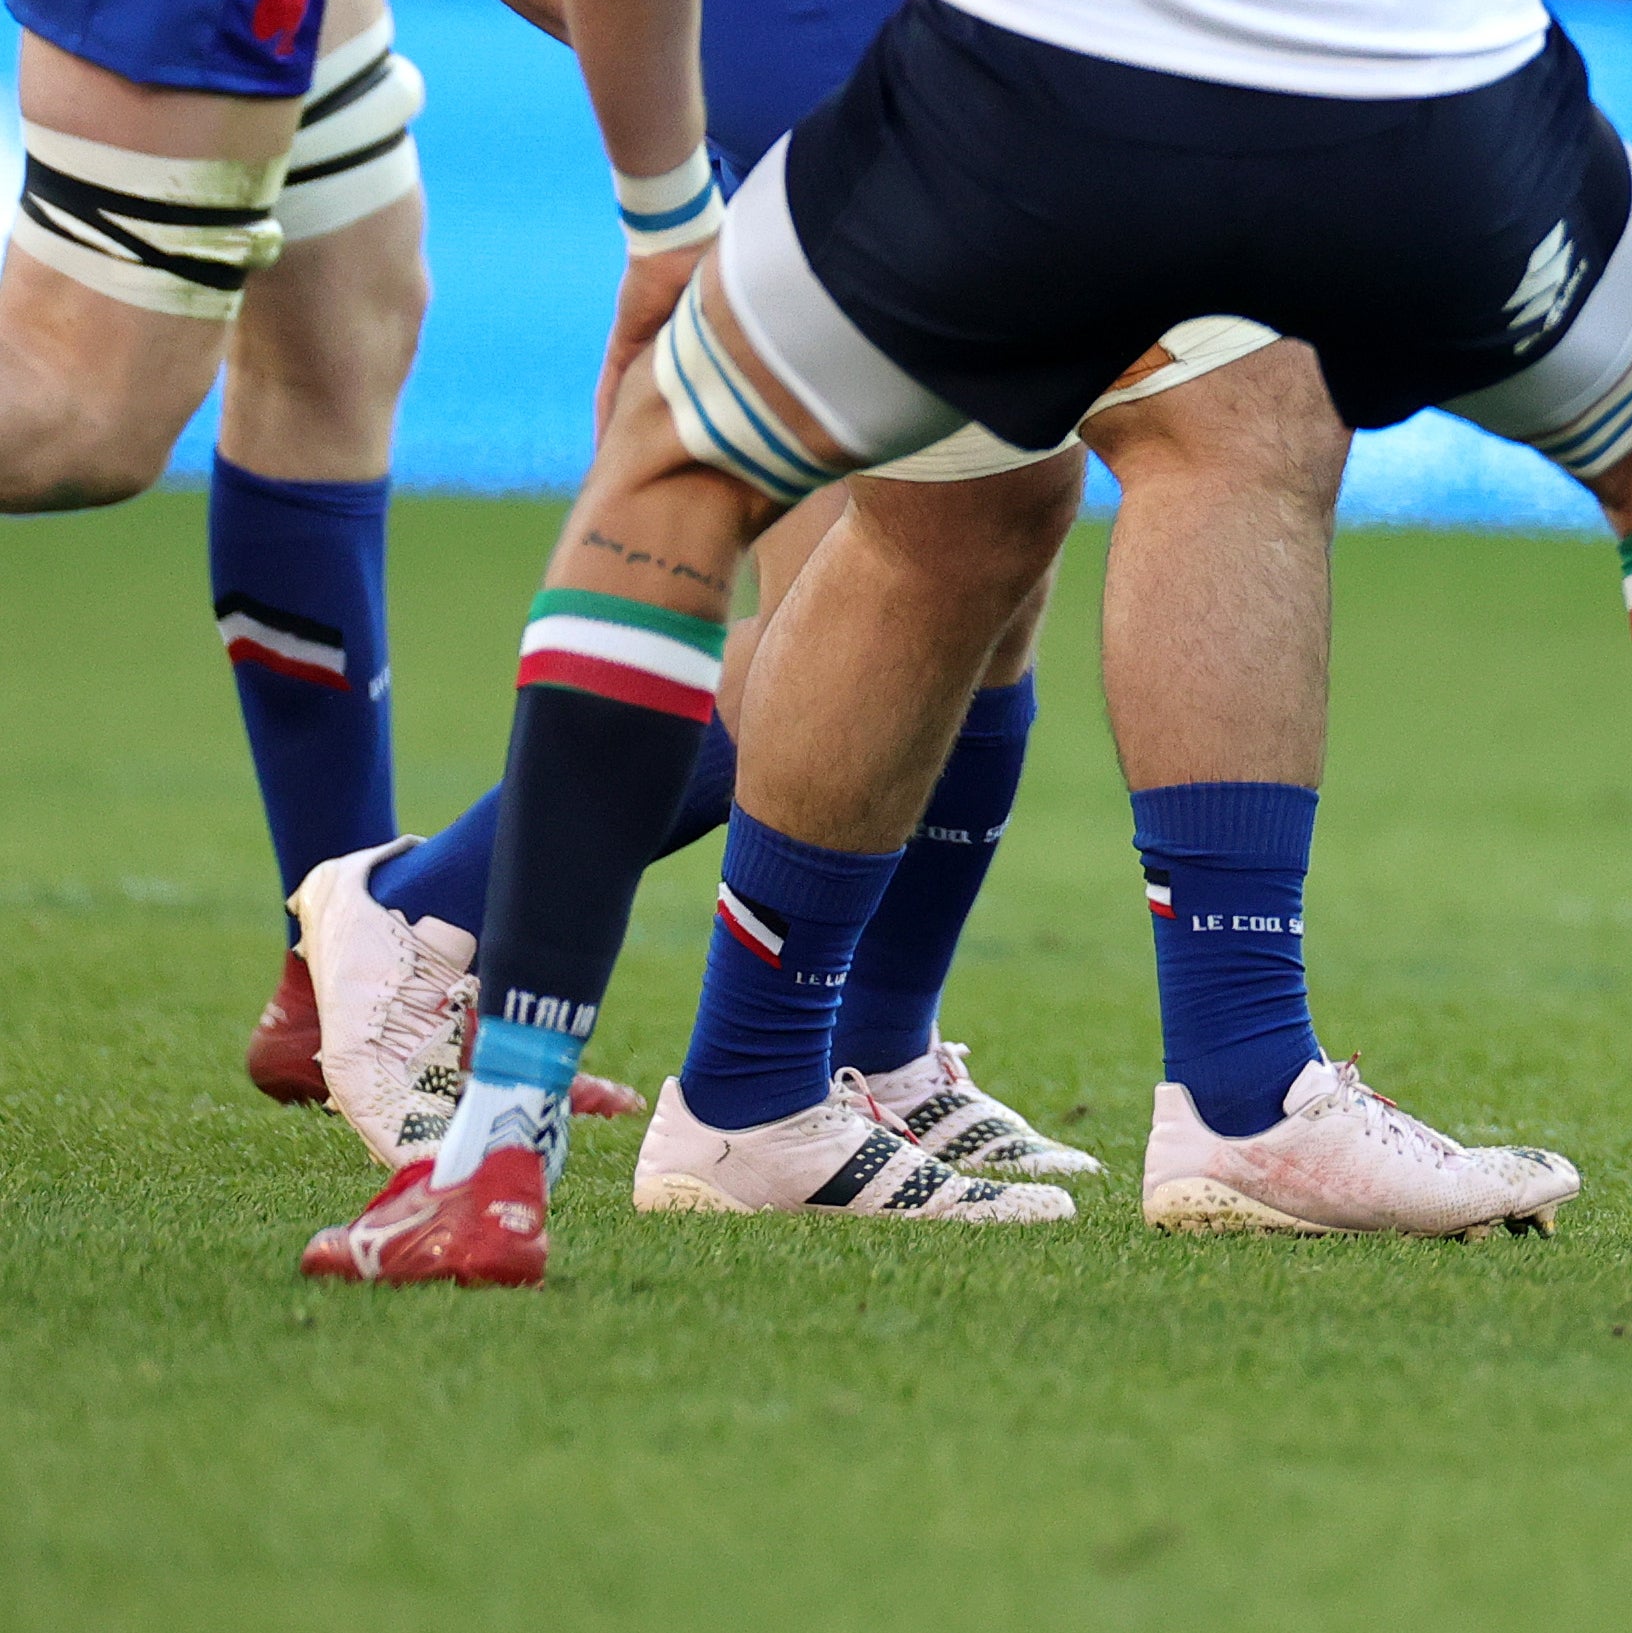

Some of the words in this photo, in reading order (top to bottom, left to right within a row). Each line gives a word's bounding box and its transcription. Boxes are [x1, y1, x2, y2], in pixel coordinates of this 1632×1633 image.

[1192, 914, 1224, 932] LE
[1232, 915, 1284, 933] COQ
[503, 988, 596, 1037] ITALIA
